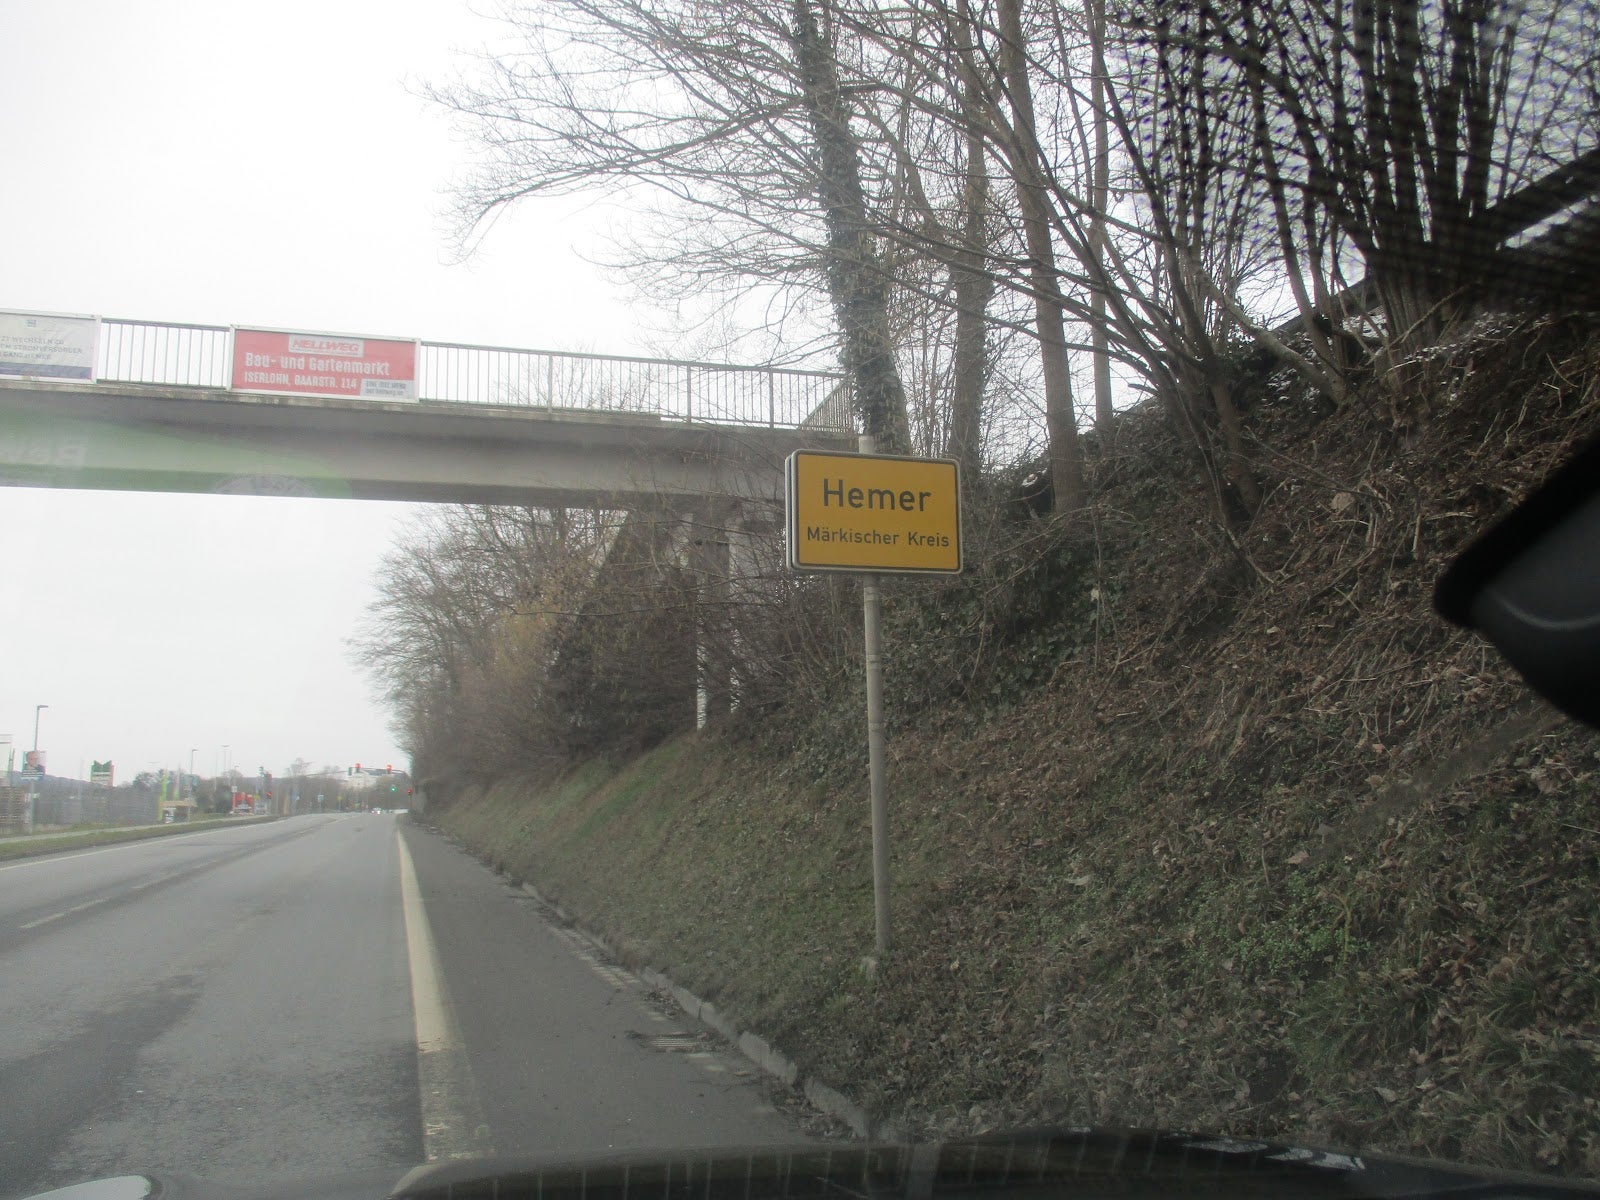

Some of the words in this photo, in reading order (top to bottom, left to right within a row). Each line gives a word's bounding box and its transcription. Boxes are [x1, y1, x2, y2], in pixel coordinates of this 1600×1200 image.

[293, 338, 360, 353] HELLWEG
[245, 352, 277, 368] Bau-
[281, 355, 305, 370] und
[309, 358, 390, 376] Gartenmarkt
[823, 478, 932, 512] Hemer
[807, 526, 900, 545] Märkischer
[908, 531, 950, 548] Kreis
